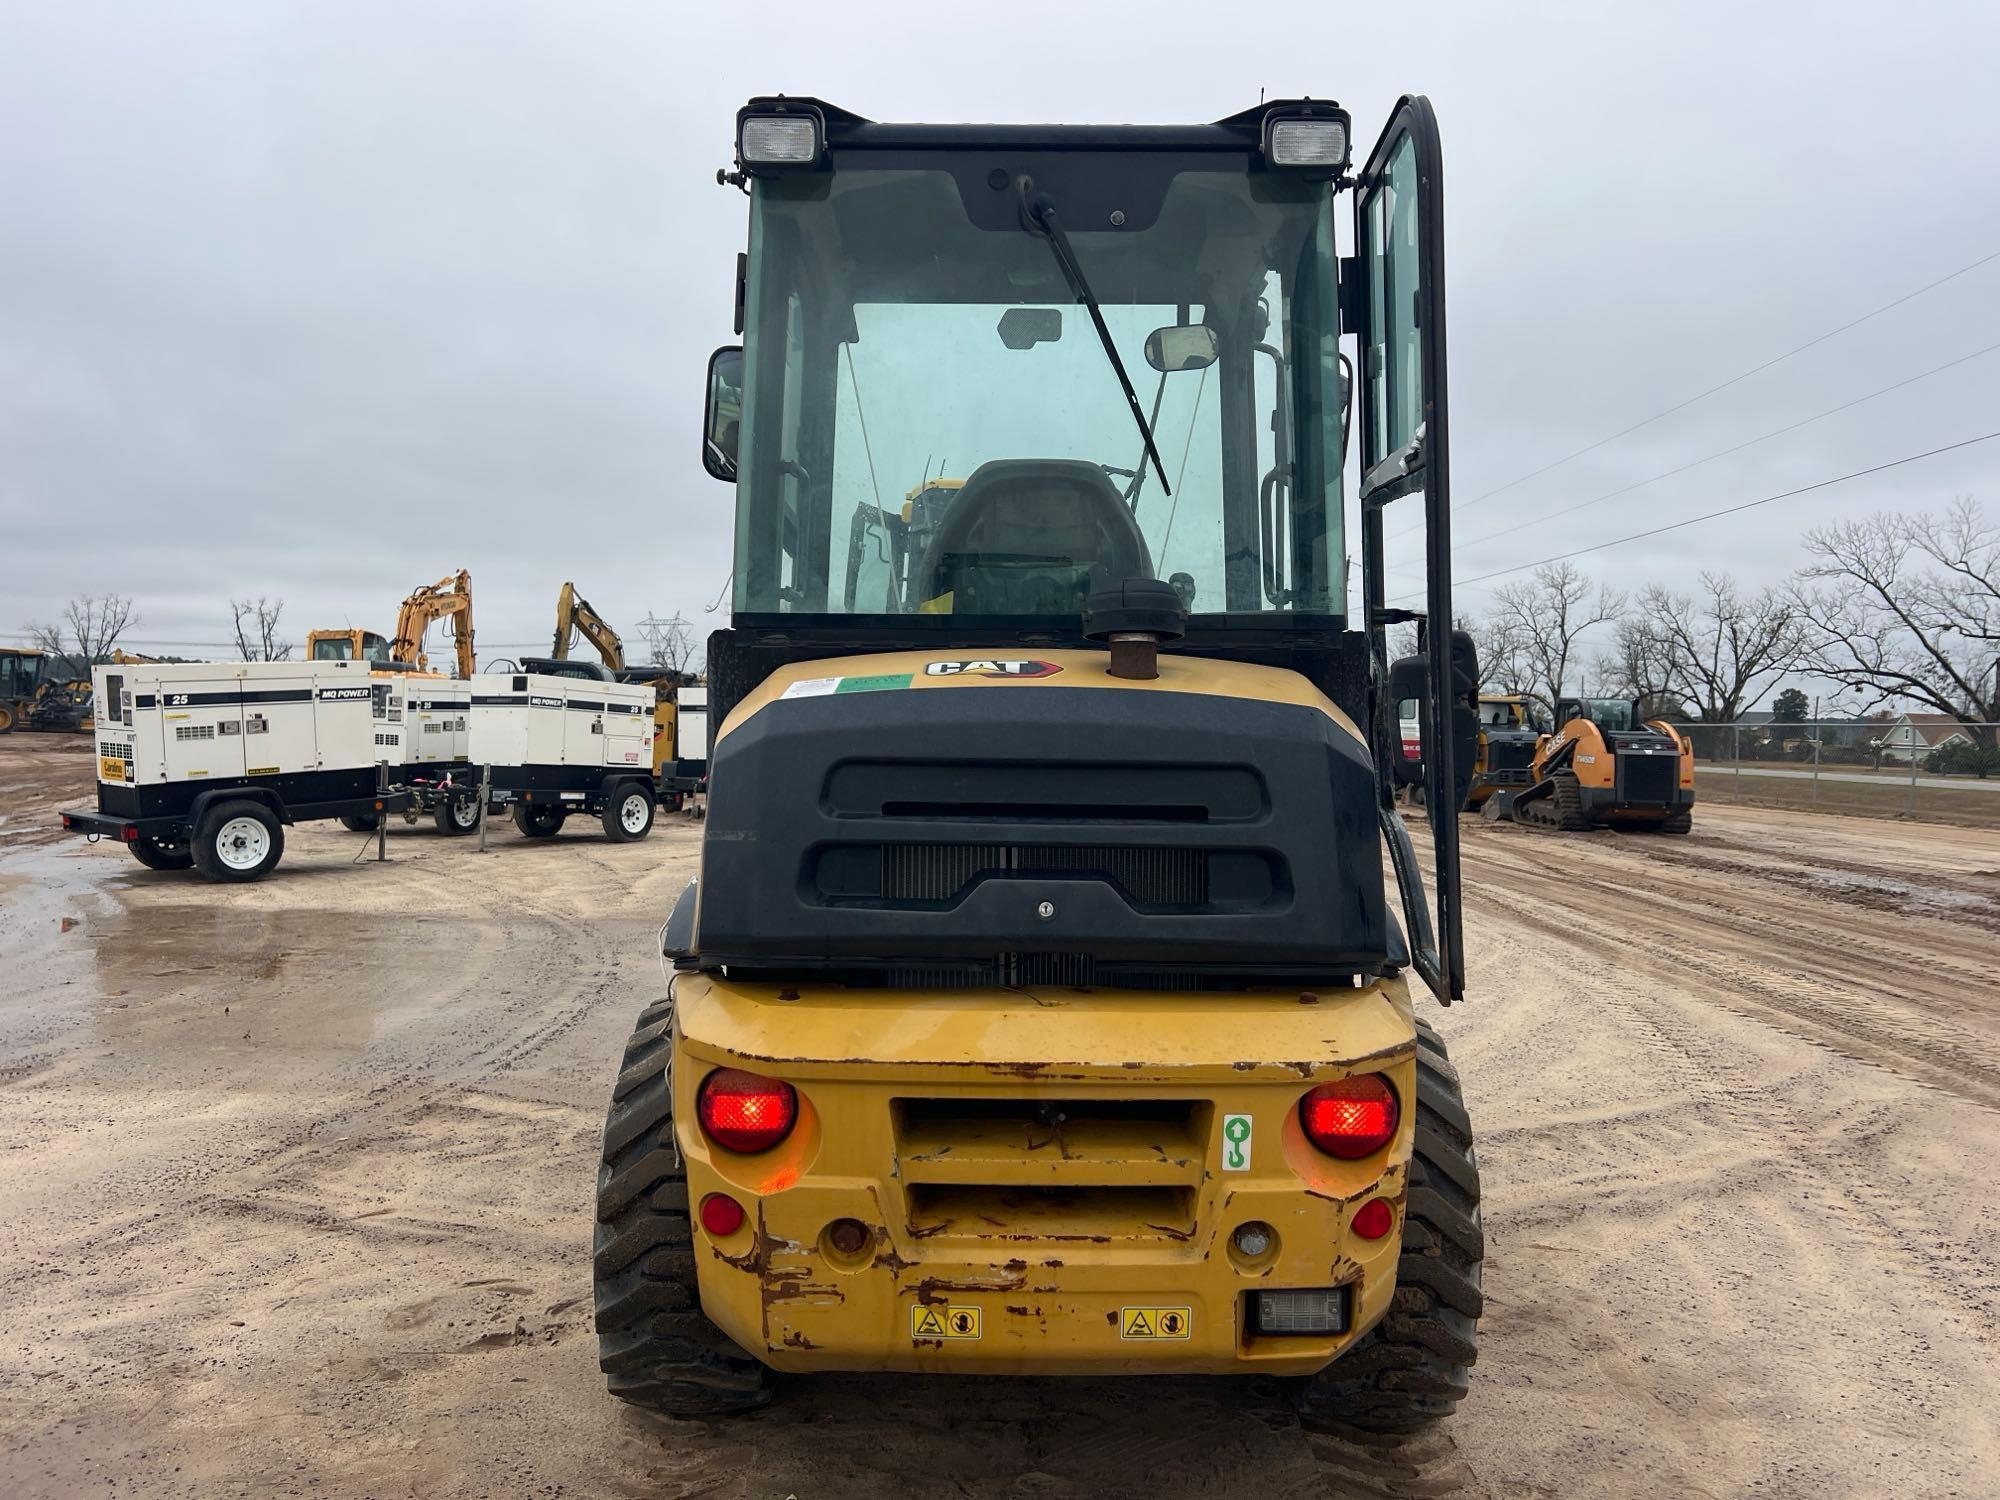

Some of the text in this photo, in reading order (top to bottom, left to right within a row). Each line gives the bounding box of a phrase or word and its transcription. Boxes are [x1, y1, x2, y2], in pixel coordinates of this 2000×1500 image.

[926, 660, 1029, 676] CAT
[172, 694, 188, 705] 25
[321, 689, 369, 699] MQ POWER
[542, 698, 562, 706] POWER
[1545, 730, 1566, 755] CASE
